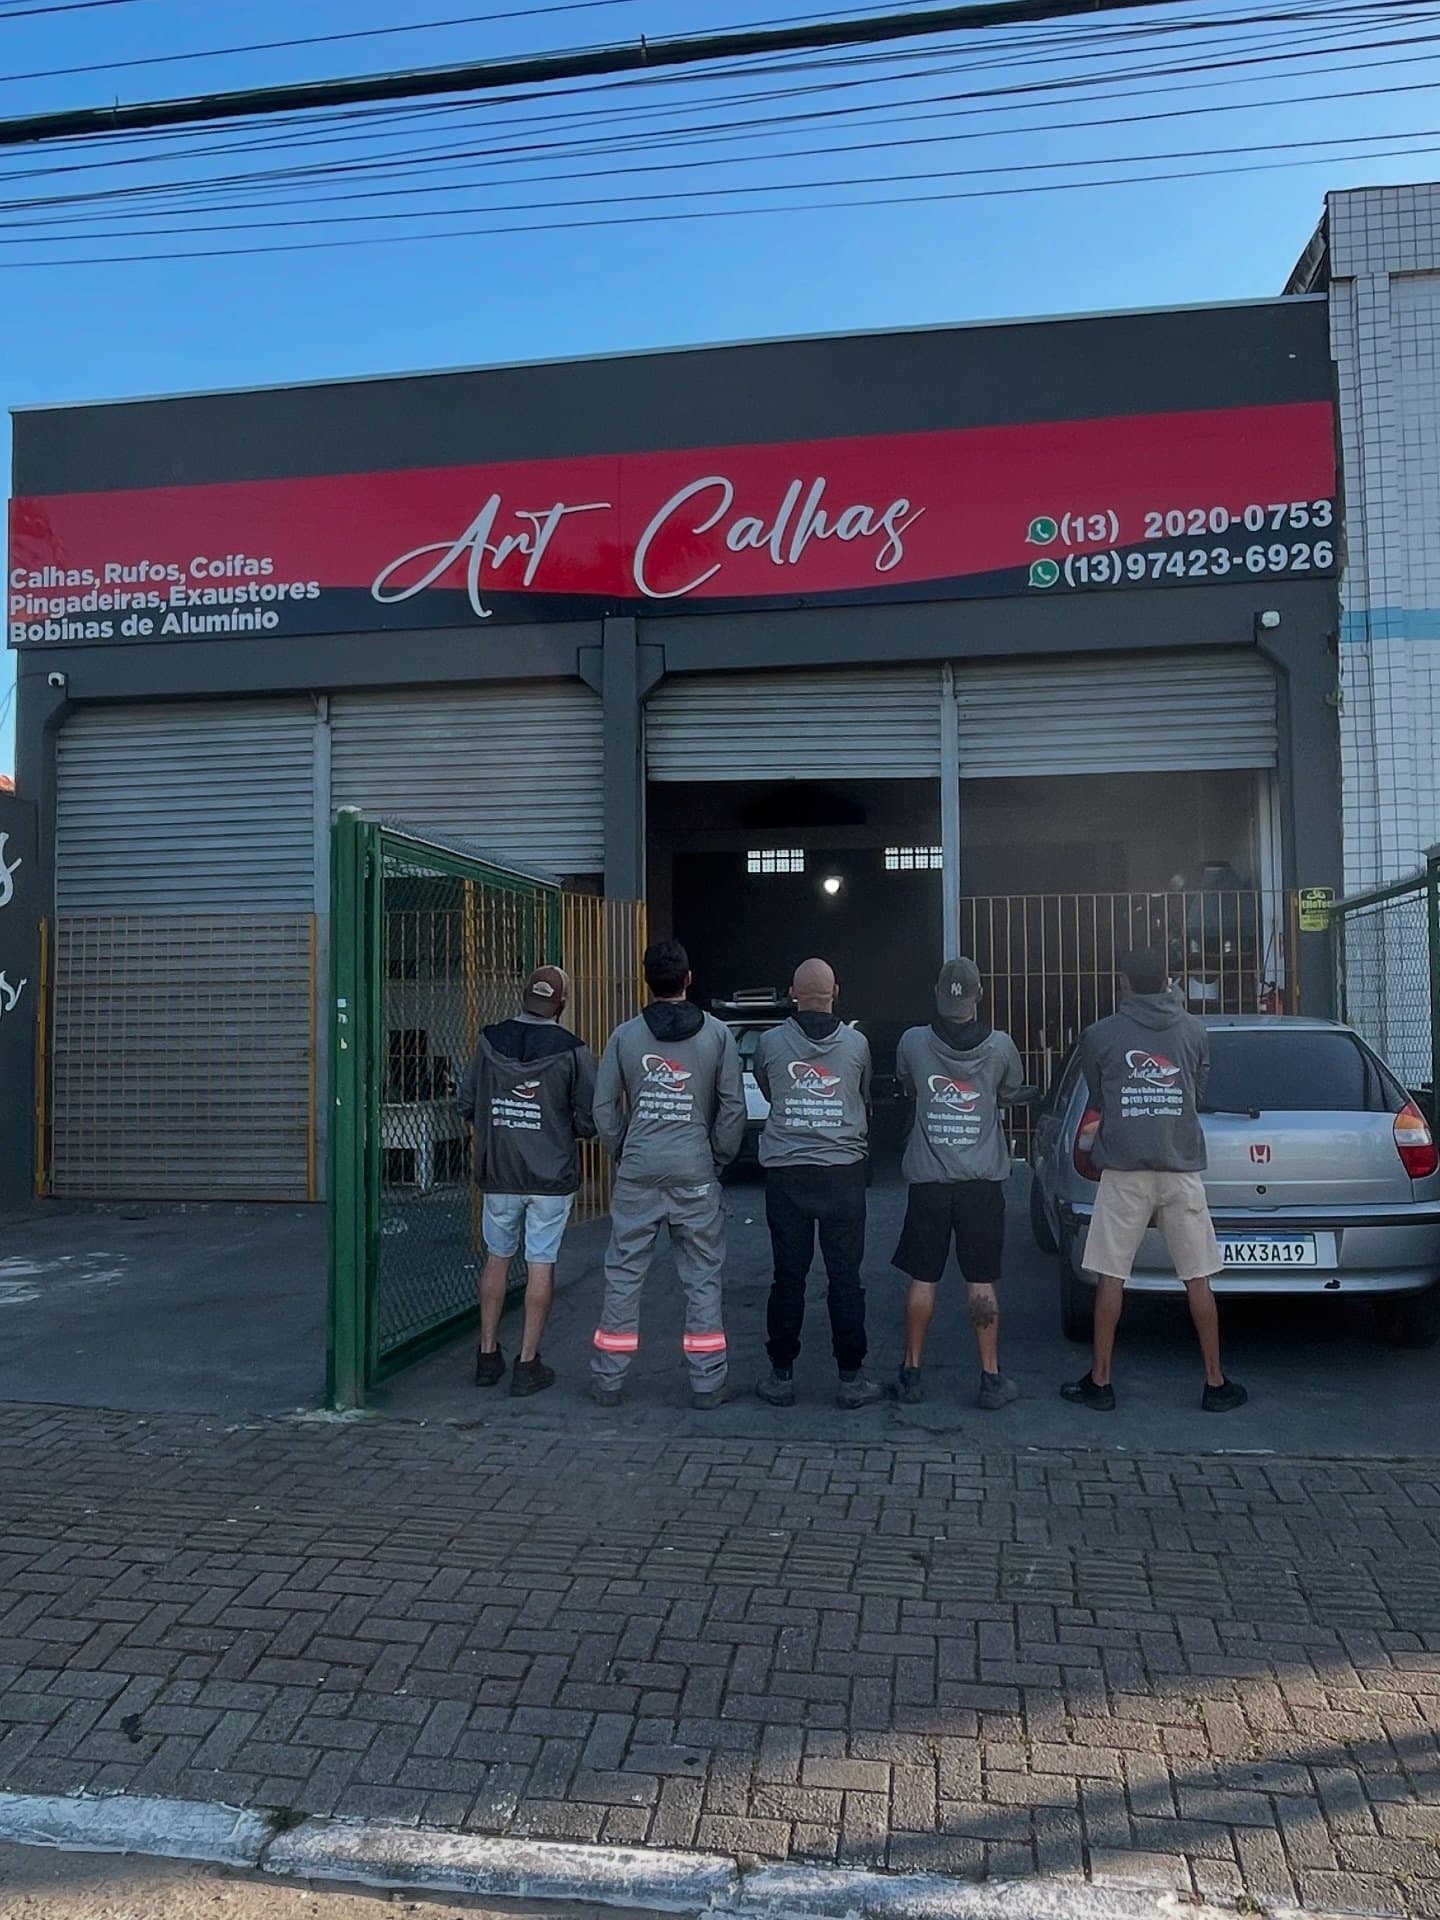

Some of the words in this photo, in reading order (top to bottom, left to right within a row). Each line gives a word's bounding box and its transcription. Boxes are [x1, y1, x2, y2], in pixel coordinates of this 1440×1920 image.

[1060, 509, 1120, 545] (13)
[1144, 500, 1333, 539] 2020-0753
[371, 493, 611, 618] Art
[633, 475, 926, 599] Calhas
[9, 565, 101, 590] Calhas,
[104, 560, 186, 585] Rufos,
[190, 554, 274, 579] Coifas
[9, 618, 114, 643] Bobinas
[121, 614, 154, 637] de
[160, 607, 280, 635] Alumínio
[1223, 1244, 1304, 1262] AKX3A19
